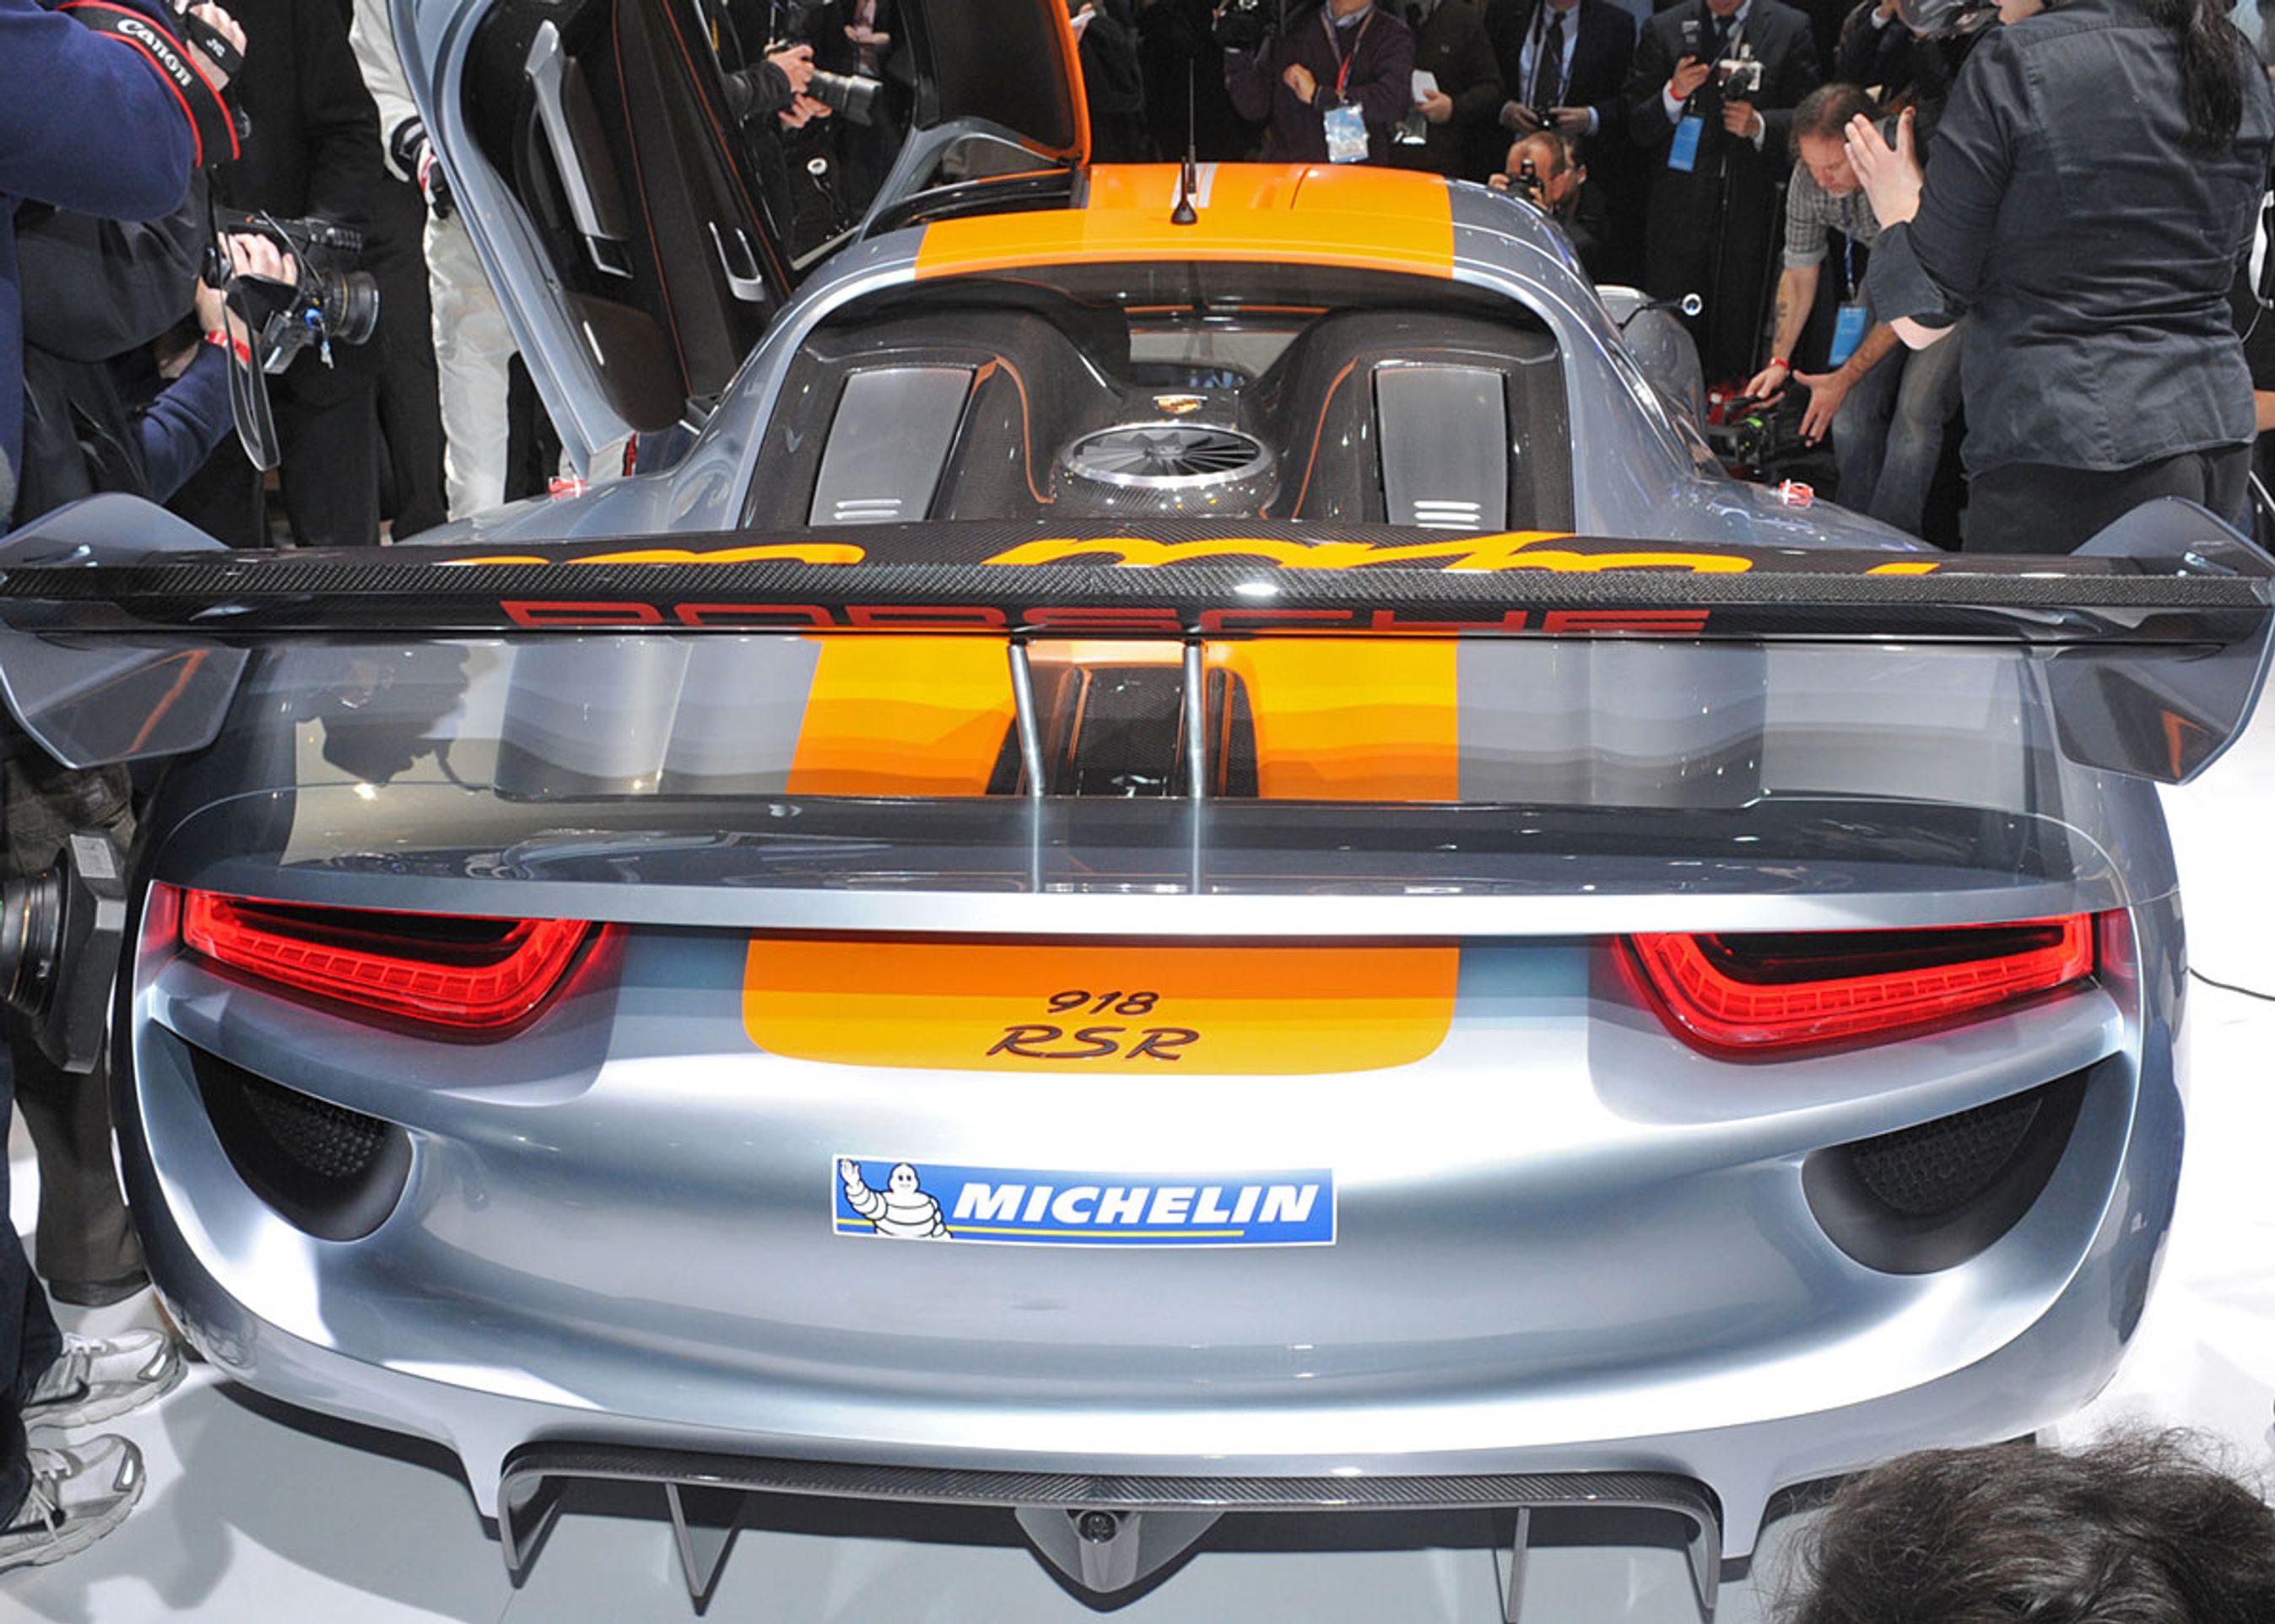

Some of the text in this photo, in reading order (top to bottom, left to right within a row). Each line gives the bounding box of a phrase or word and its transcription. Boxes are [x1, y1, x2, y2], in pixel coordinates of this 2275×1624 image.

[116, 19, 193, 86] Canon
[1047, 990, 1160, 1015] 918
[986, 1024, 1200, 1061] RSR
[953, 1183, 1320, 1225] MICHELIN
